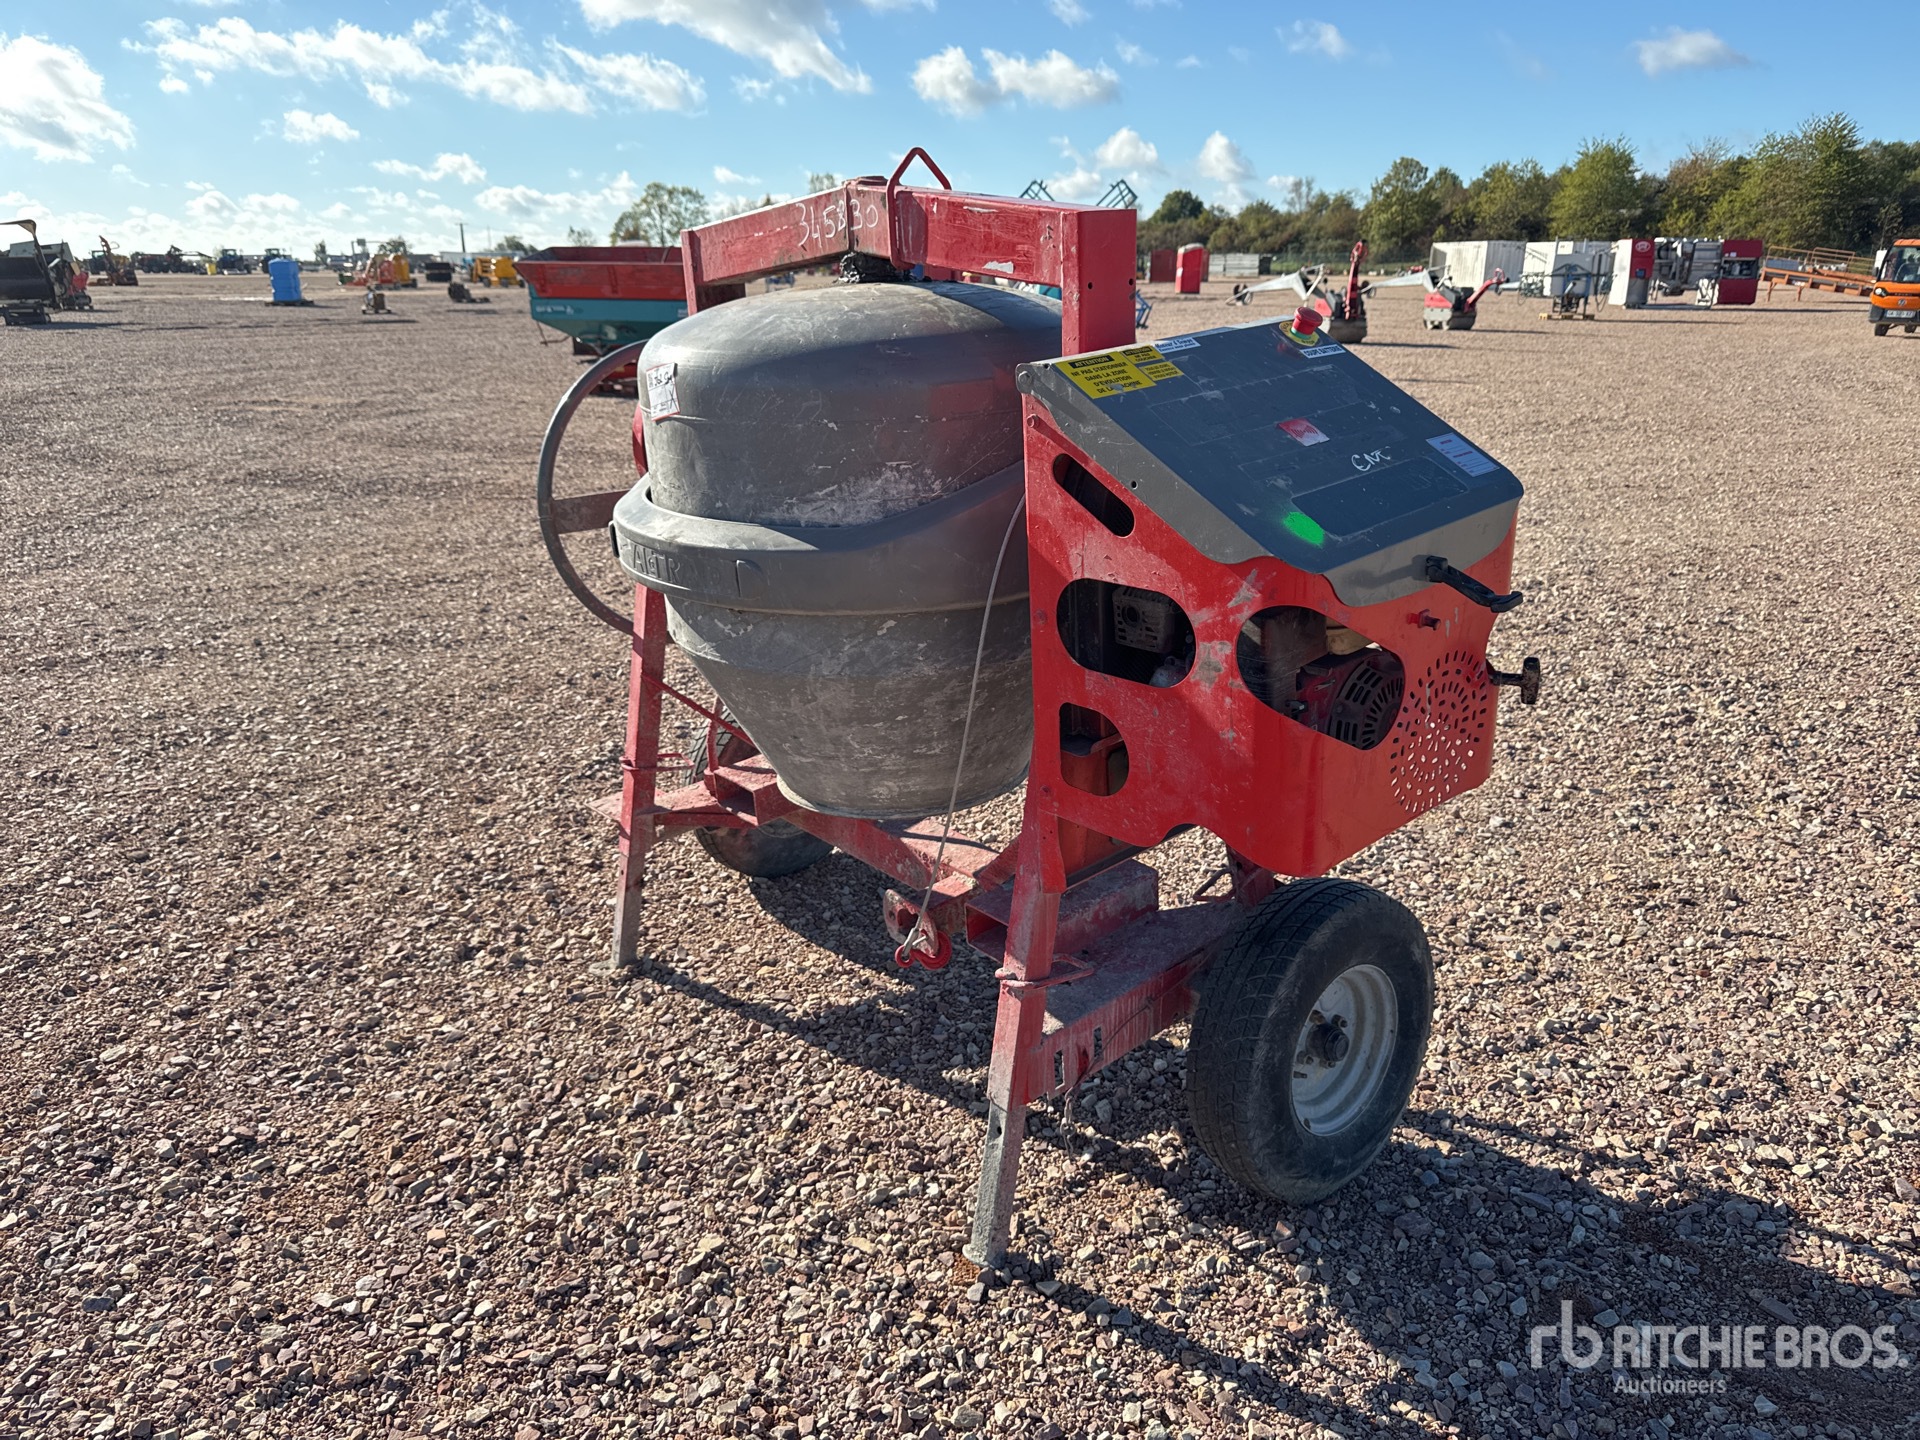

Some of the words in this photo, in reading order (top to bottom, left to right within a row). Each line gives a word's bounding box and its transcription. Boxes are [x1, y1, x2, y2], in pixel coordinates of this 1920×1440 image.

[1074, 356, 1109, 367] ATTENTION
[1093, 362, 1128, 373] STATIONNER
[1085, 373, 1103, 381] DANS
